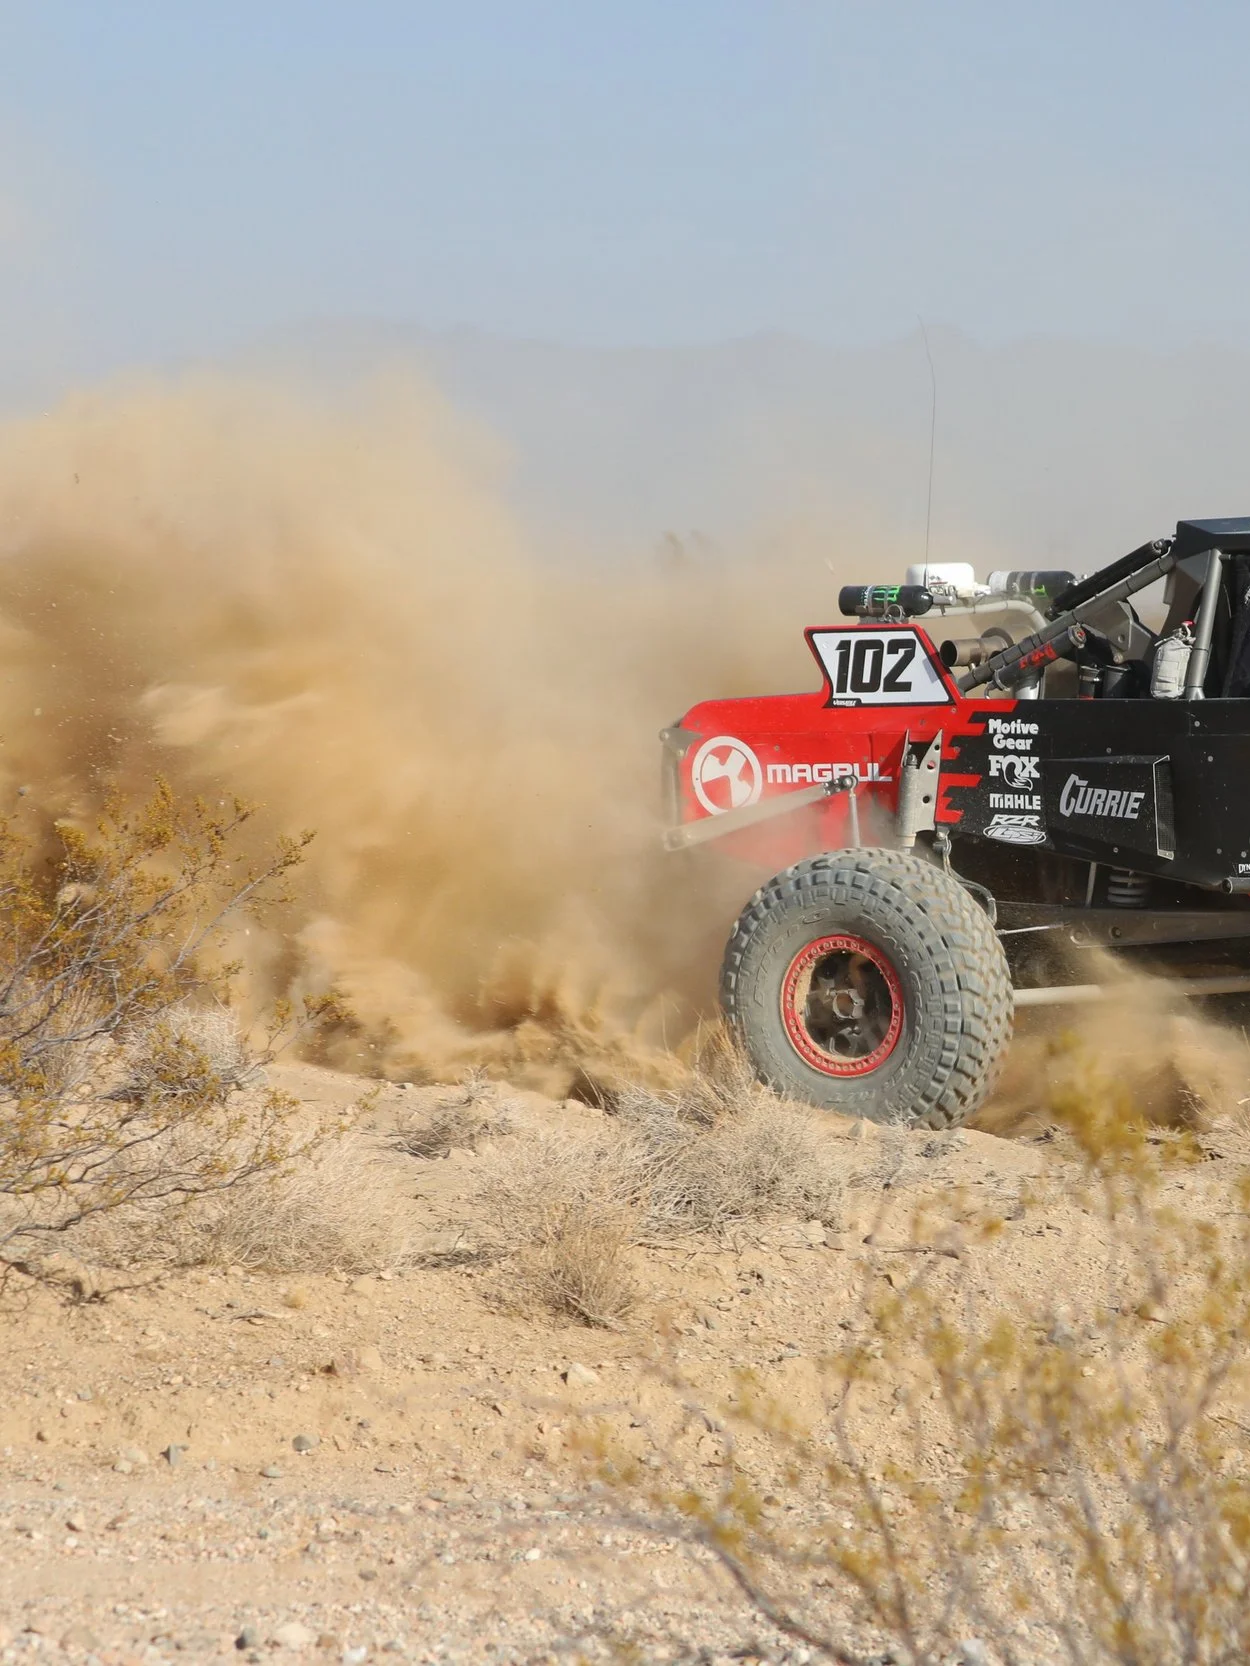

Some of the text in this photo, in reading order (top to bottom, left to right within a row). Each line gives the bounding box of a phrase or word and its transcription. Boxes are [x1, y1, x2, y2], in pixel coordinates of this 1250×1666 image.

[835, 638, 917, 694] 102
[988, 718, 1039, 735] Motive
[992, 733, 1033, 751] Gear
[766, 762, 893, 784] MAGPUL
[988, 754, 1041, 782] FOX
[989, 793, 1042, 810] MAHLE
[1059, 773, 1146, 820] CURRIE
[989, 814, 1041, 827] RZR
